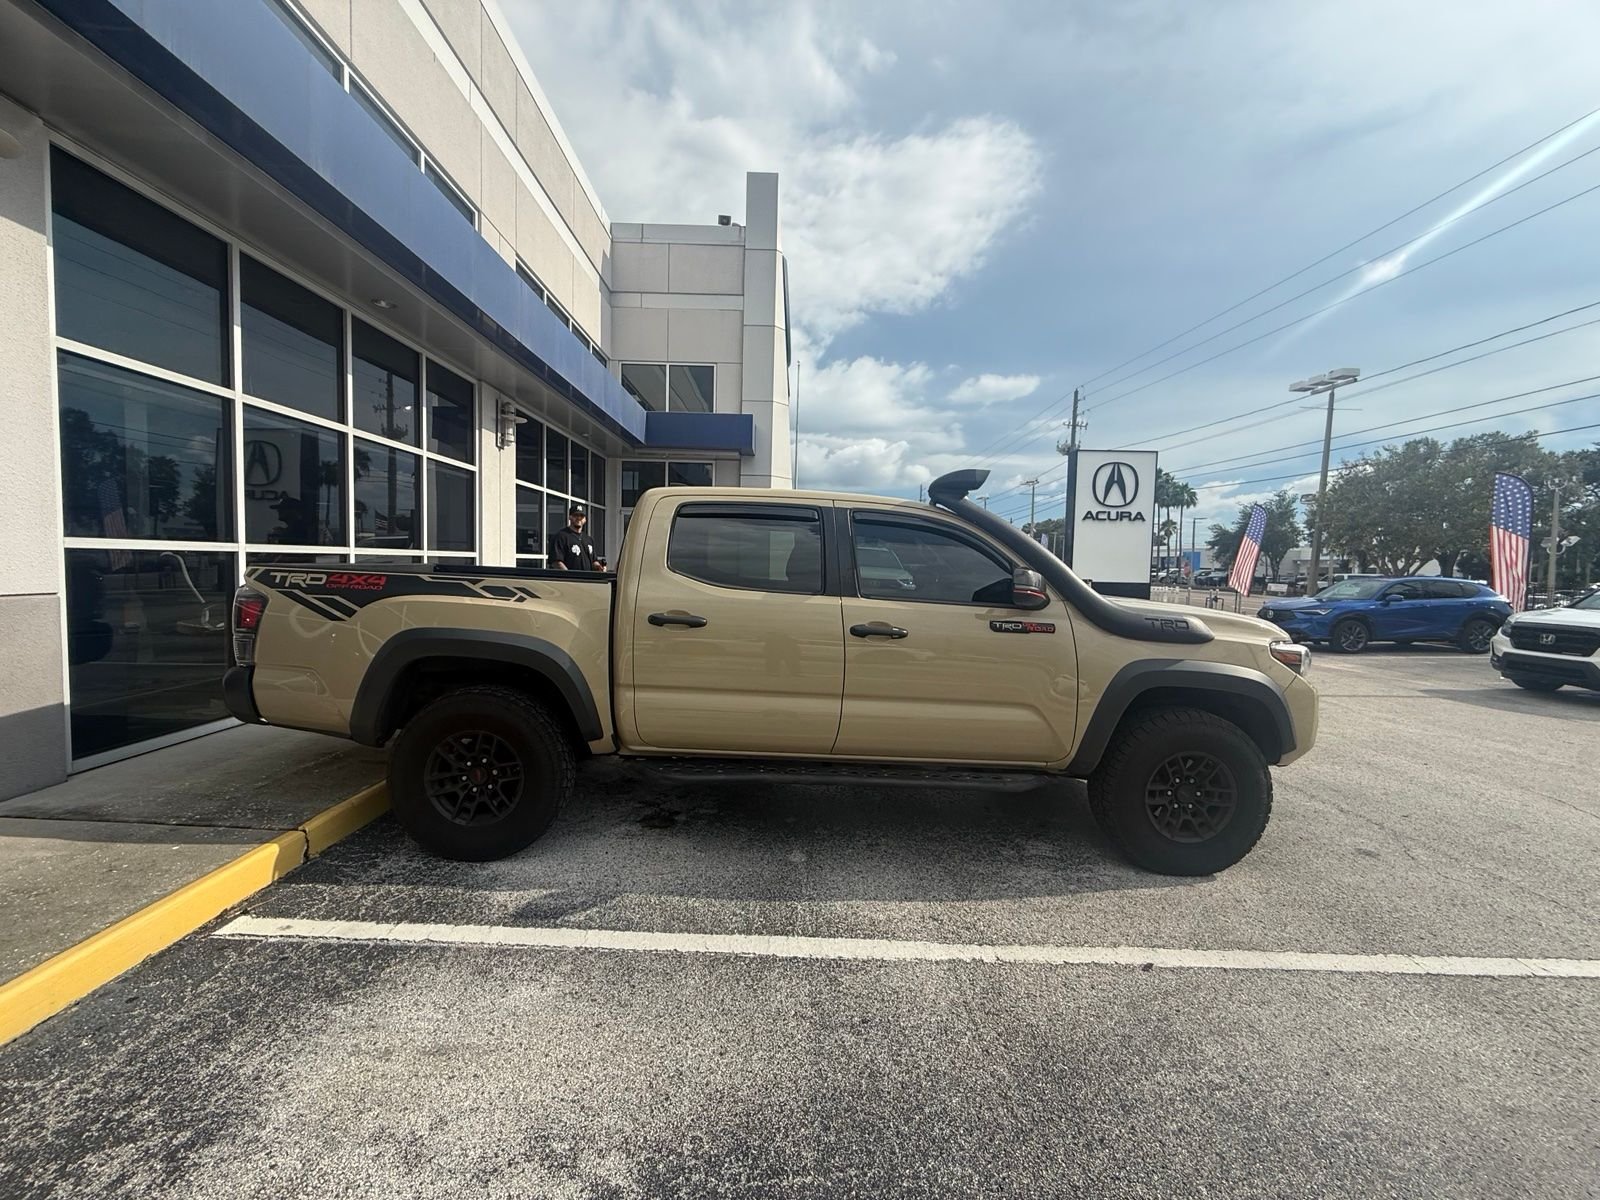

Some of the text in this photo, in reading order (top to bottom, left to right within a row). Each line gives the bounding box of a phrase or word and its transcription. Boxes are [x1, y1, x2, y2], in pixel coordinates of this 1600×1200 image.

[1082, 510, 1146, 522] ACURA
[269, 571, 327, 588] TRD
[992, 621, 1022, 631] TRD
[1143, 617, 1190, 632] TRD
